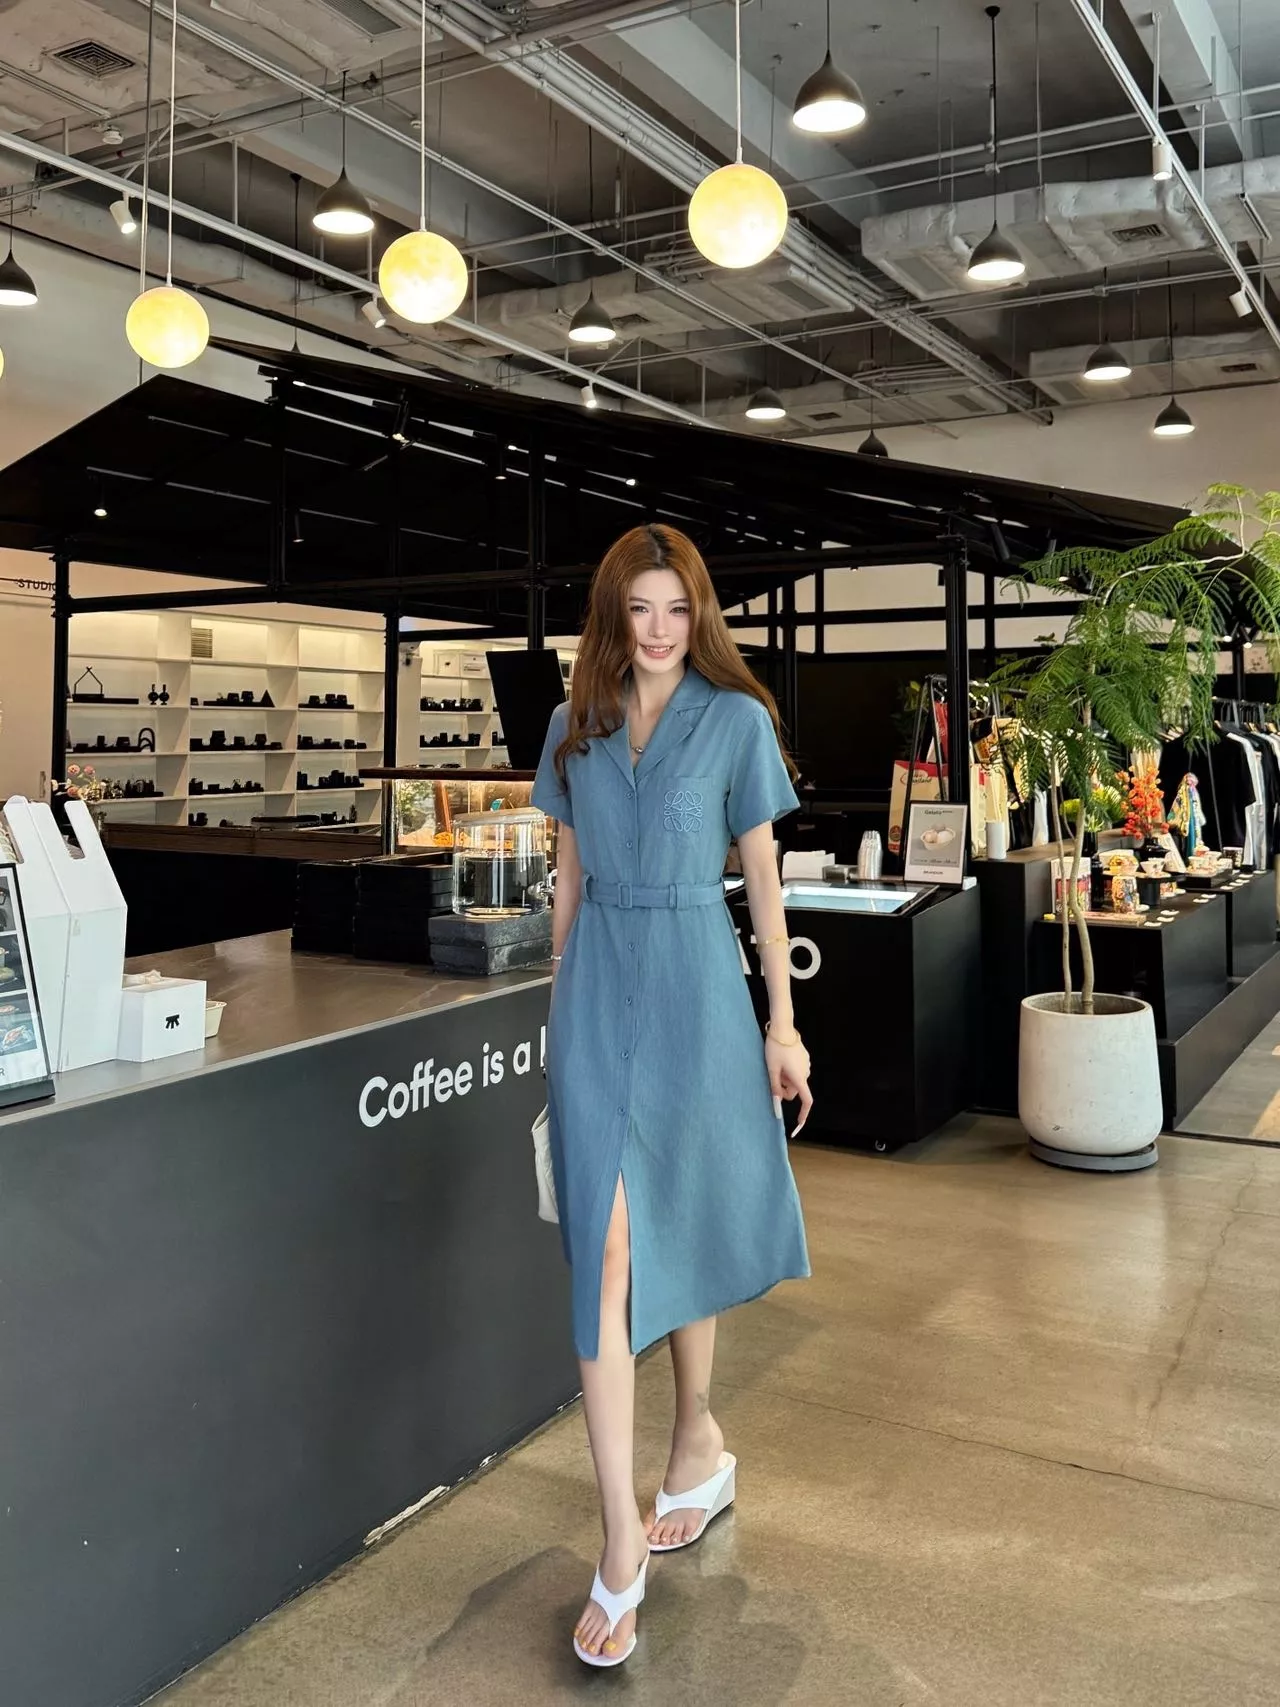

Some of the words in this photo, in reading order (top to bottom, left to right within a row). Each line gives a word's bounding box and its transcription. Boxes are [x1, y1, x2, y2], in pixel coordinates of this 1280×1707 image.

[359, 1058, 473, 1127] Coffee
[483, 1042, 504, 1087] is
[513, 1041, 531, 1075] a
